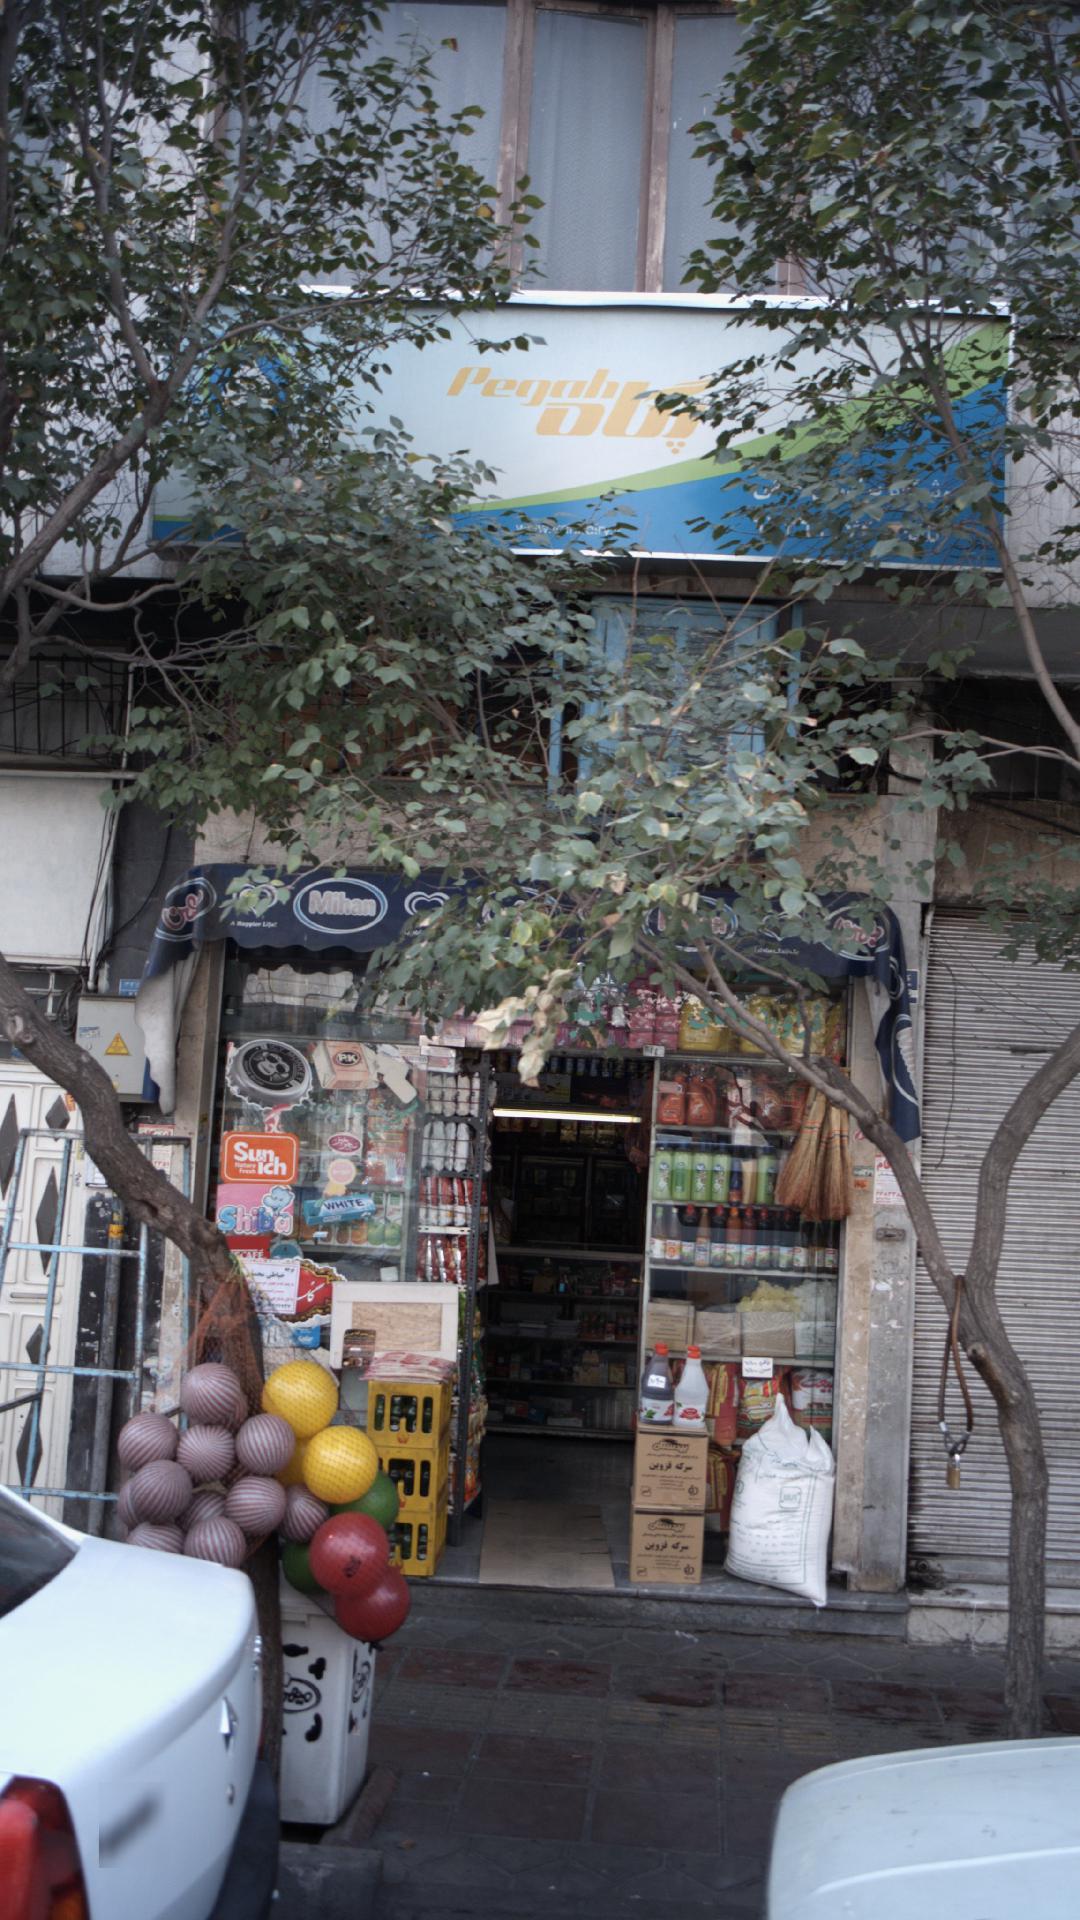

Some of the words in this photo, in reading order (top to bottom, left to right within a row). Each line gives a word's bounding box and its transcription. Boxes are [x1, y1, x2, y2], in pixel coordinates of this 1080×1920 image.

[447, 366, 619, 407] Pegah
[308, 889, 377, 917] Mihan
[233, 1141, 275, 1162] Sun
[324, 1198, 365, 1211] WHITE
[217, 1205, 294, 1236] Shiba
